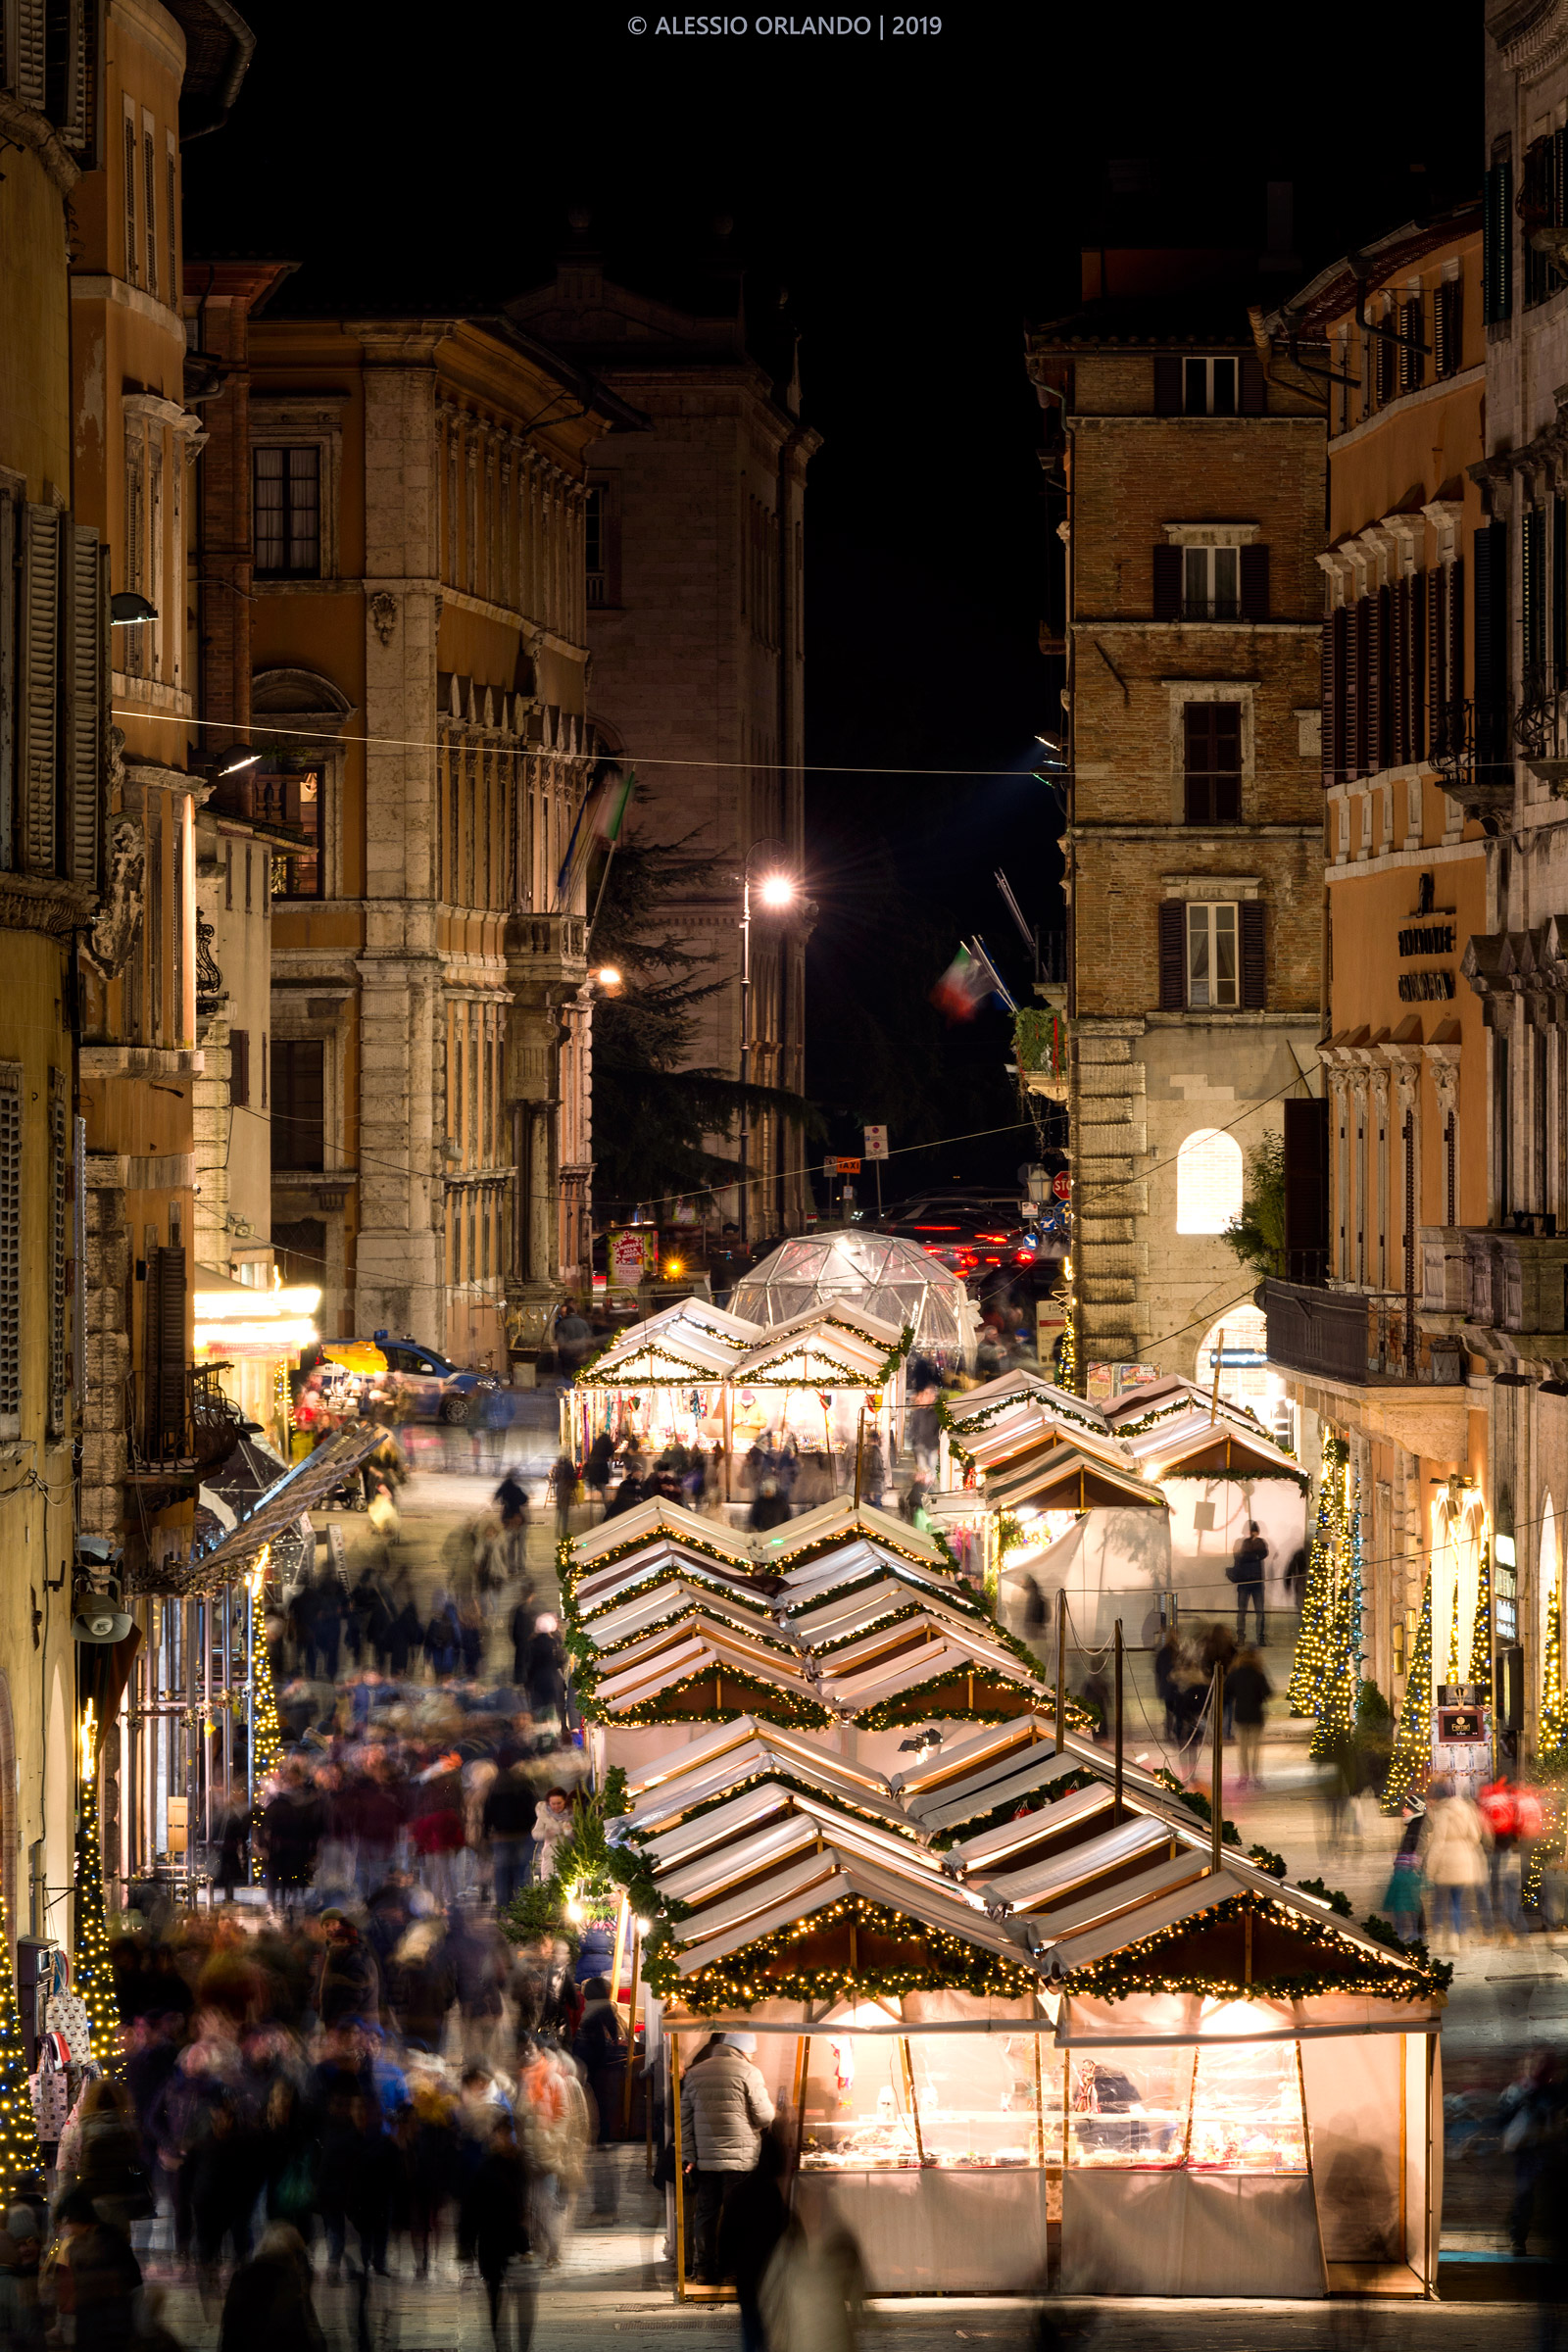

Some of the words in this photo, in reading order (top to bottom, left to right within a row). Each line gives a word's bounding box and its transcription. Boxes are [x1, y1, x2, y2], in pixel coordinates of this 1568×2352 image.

[839, 1160, 859, 1169] TAXI
[1054, 1180, 1072, 1192] STO
[619, 1241, 640, 1250] NATALE
